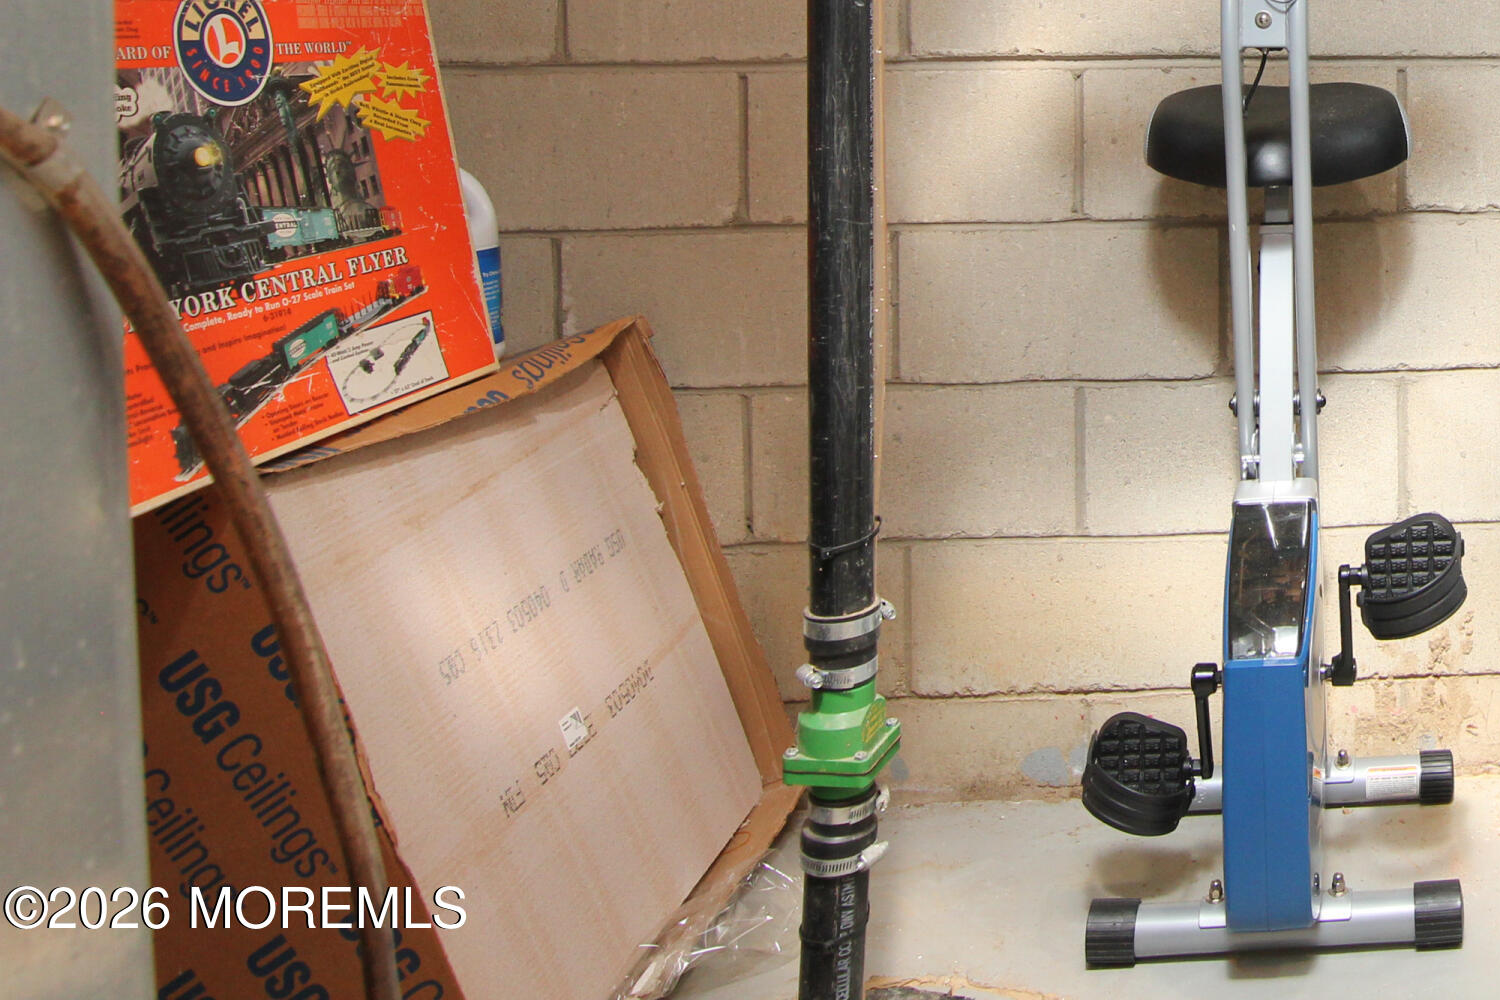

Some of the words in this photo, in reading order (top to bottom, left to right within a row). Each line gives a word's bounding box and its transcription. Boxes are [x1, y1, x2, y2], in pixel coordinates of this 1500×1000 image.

[116, 47, 147, 60] ARD
[151, 46, 172, 59] OF
[276, 43, 301, 55] THE
[186, 47, 230, 92] SINCE
[169, 286, 237, 322] YORK
[240, 262, 343, 303] CENTRAL
[347, 246, 409, 279] FLYER
[183, 316, 226, 333] Complete,
[227, 307, 254, 325] Ready
[255, 304, 264, 314] to
[265, 298, 281, 311] Run
[303, 289, 323, 303] Scale
[324, 284, 343, 299] Train
[344, 281, 356, 292] Set
[158, 650, 241, 745] USG
